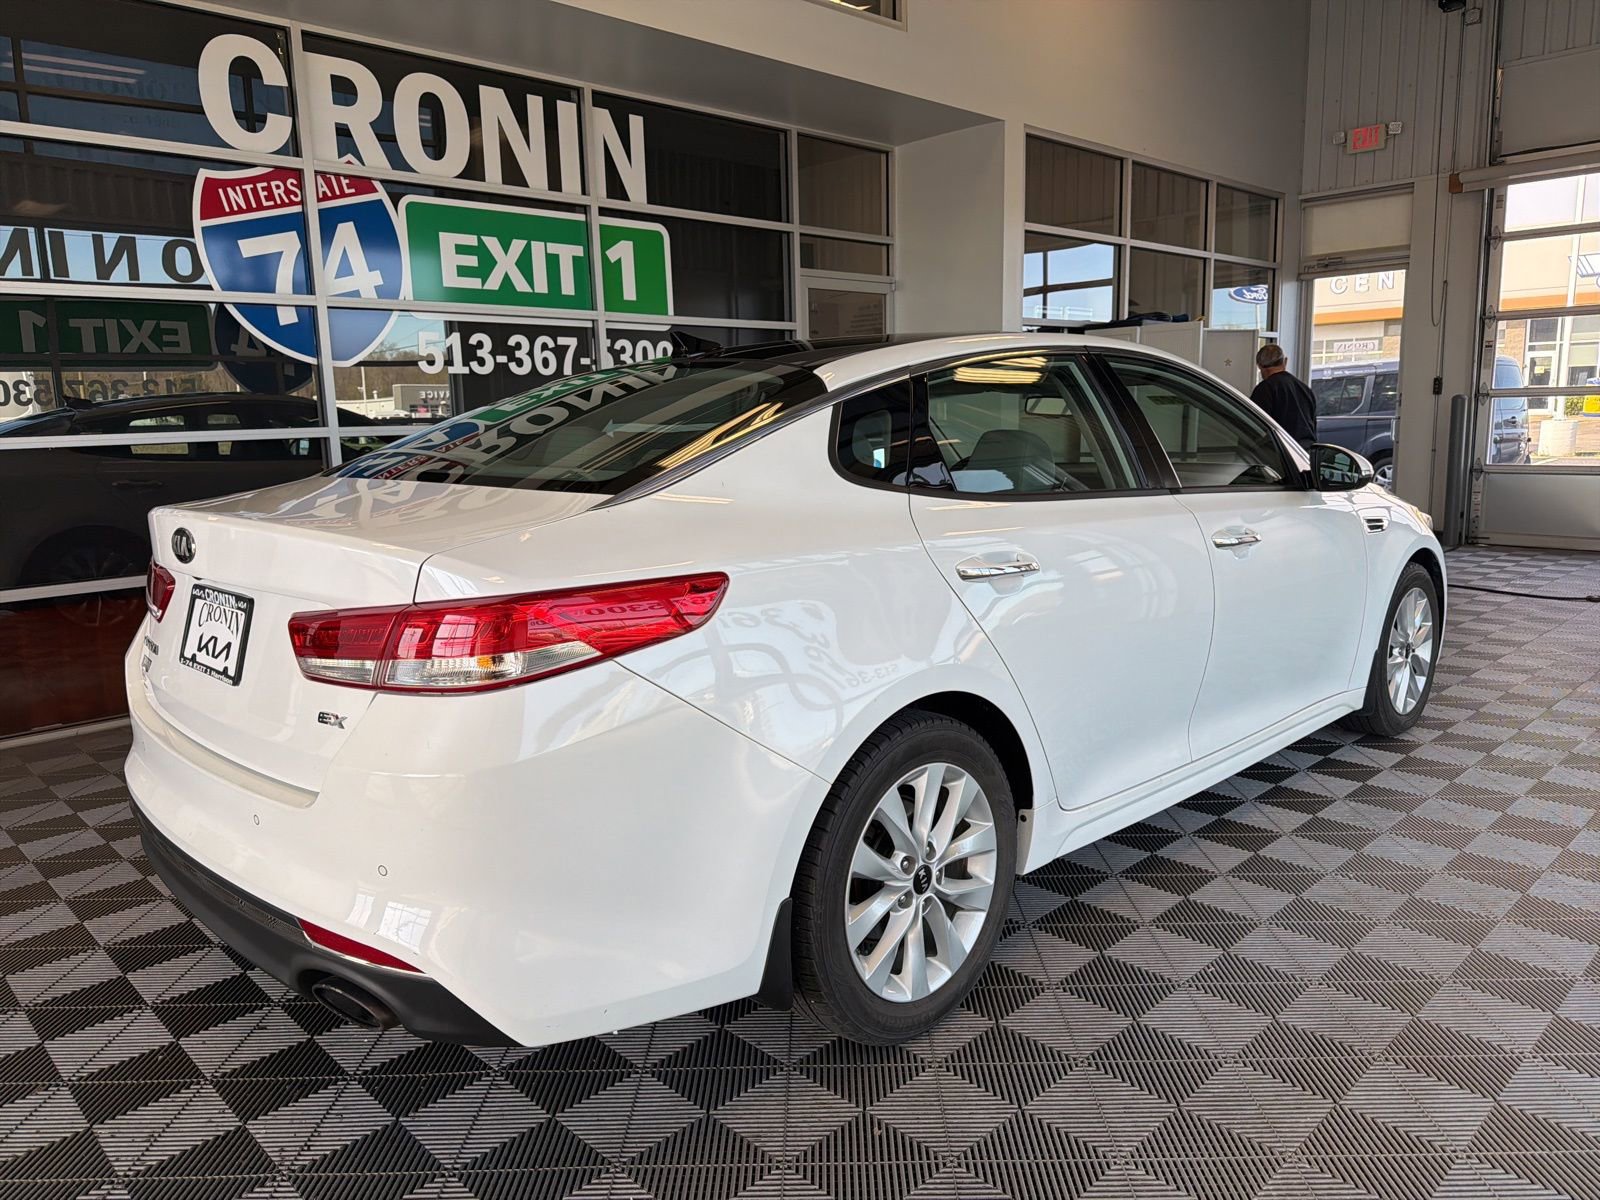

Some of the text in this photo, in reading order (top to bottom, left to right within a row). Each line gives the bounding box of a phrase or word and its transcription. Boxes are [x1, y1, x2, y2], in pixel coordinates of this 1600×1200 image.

[198, 33, 647, 203] CRONIN
[1352, 125, 1379, 150] EXIT
[218, 175, 356, 213] INTERSATE
[238, 220, 382, 326] 74
[438, 231, 638, 302] EXIT 1
[172, 534, 190, 557] KIA
[205, 588, 236, 610] CRONIN
[198, 601, 243, 641] CRONIN
[210, 669, 234, 685] Harrison
[317, 711, 348, 730] EX
[918, 868, 929, 892] KIA
